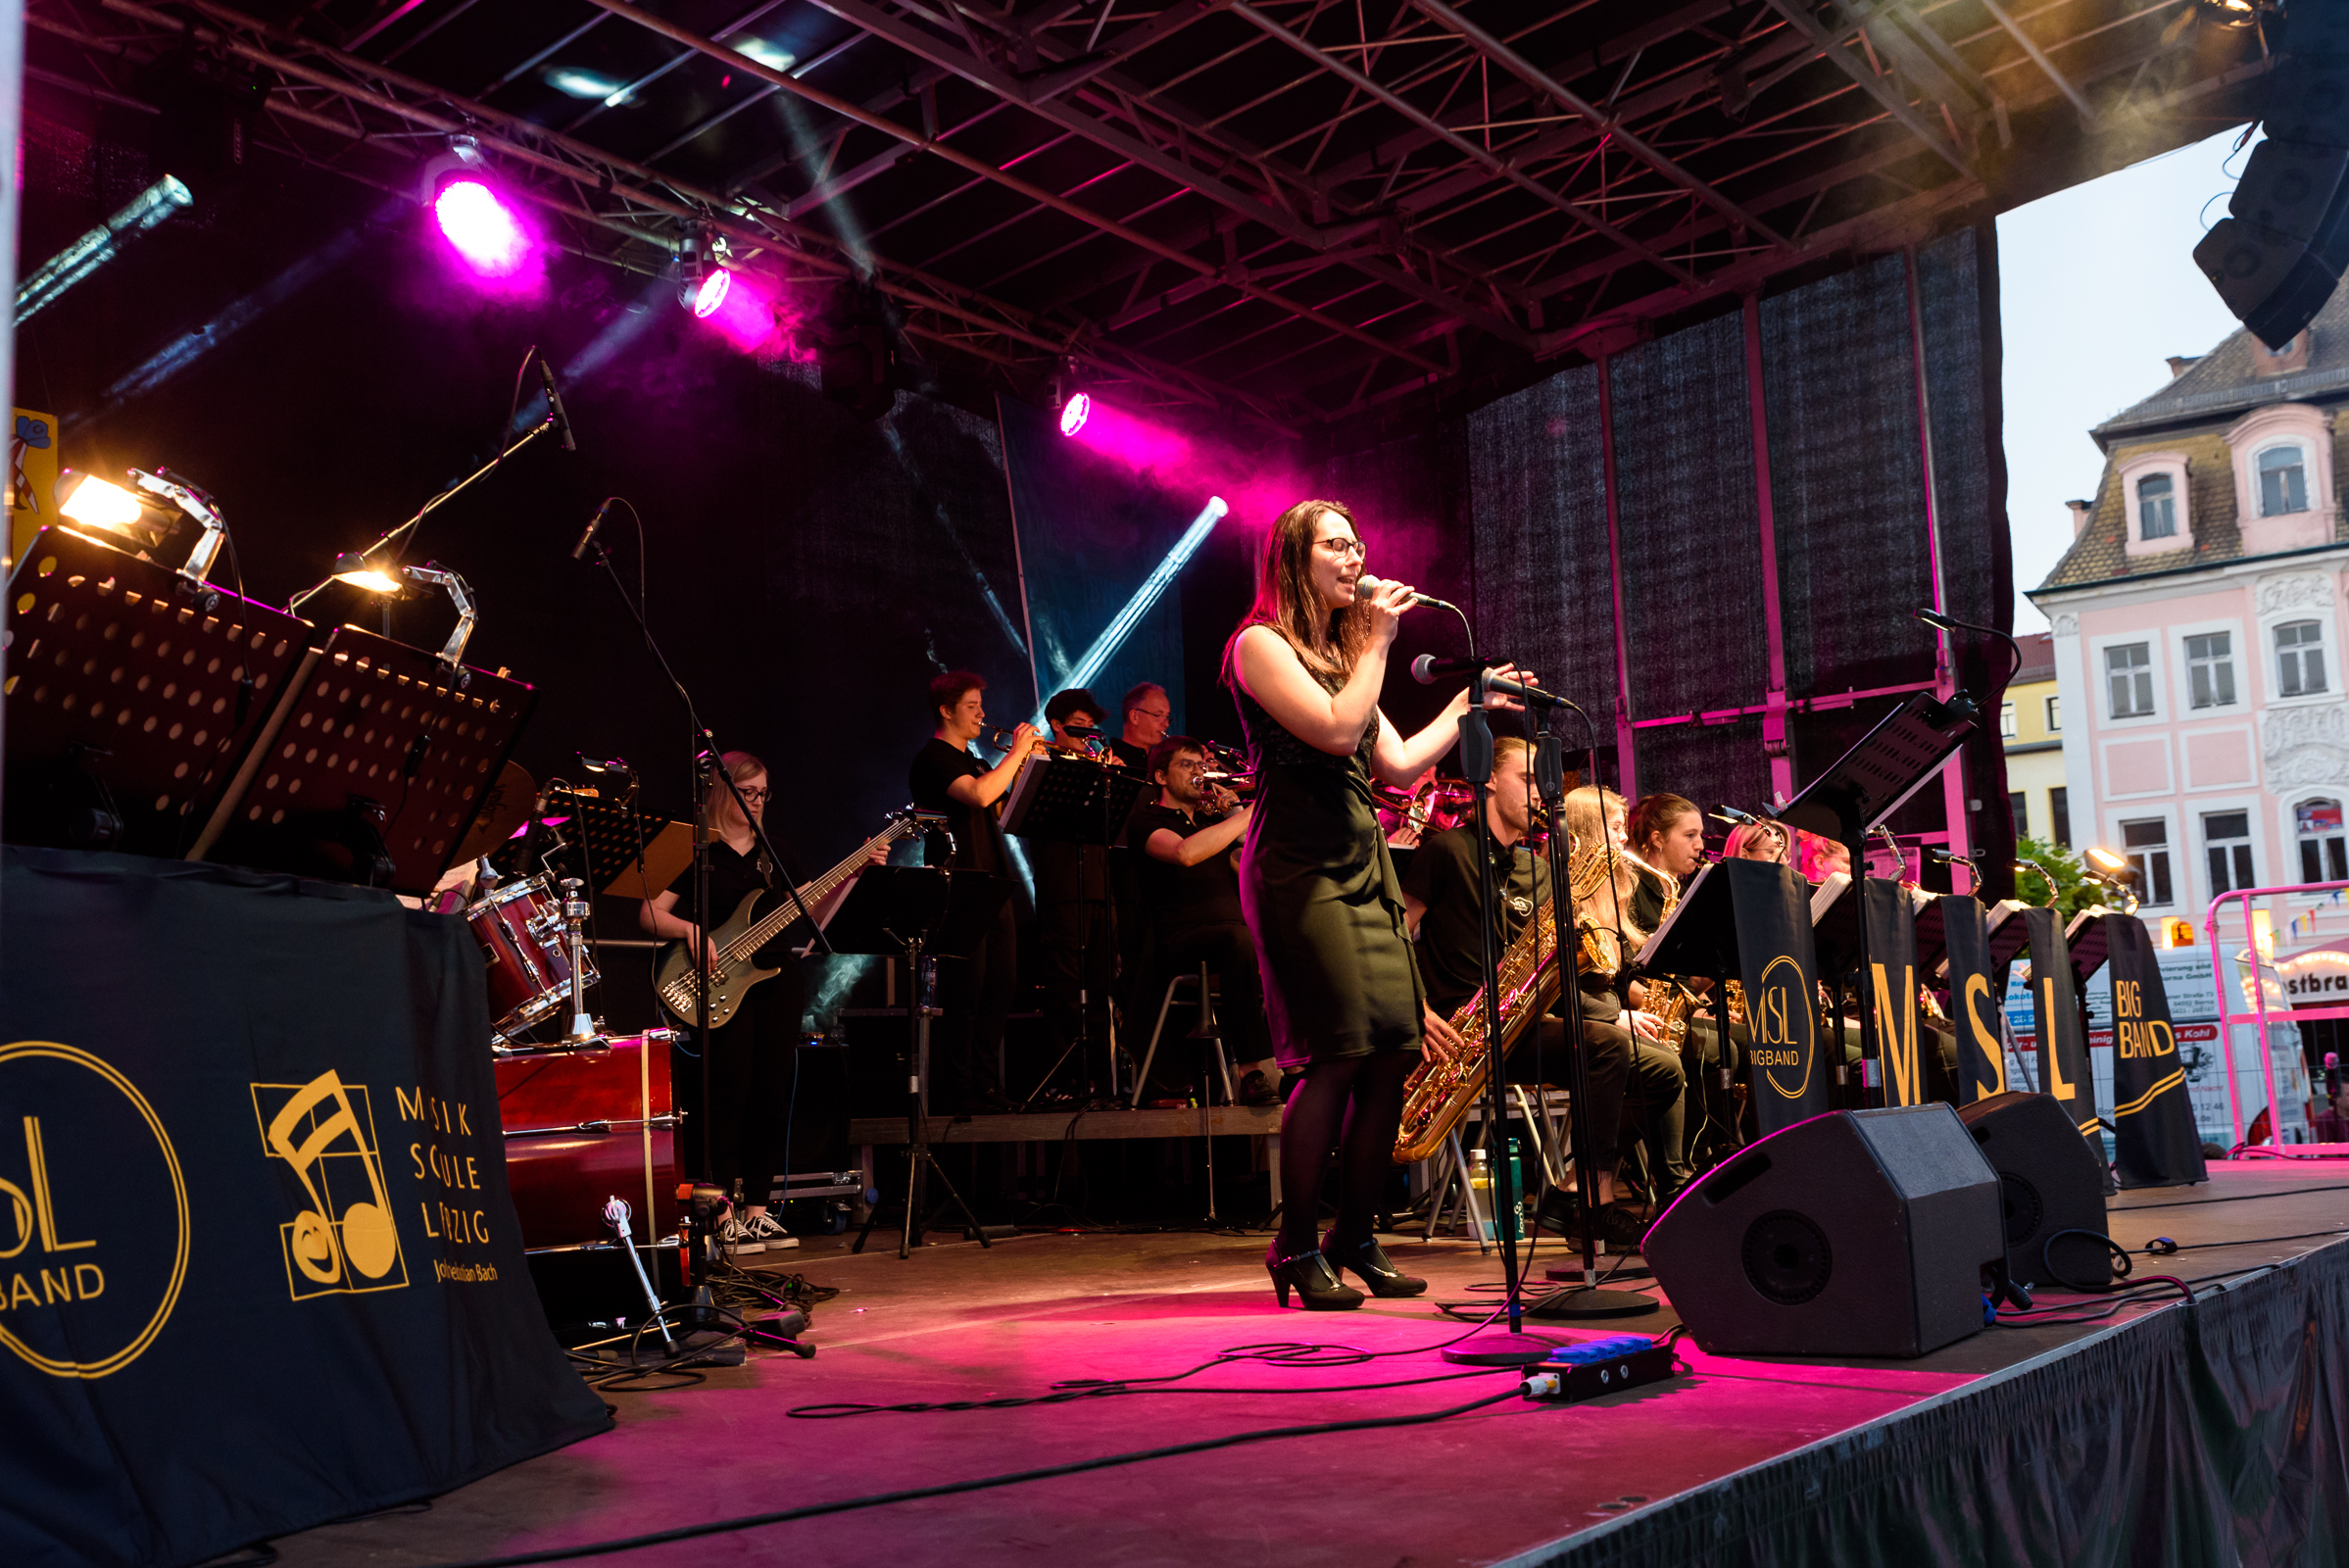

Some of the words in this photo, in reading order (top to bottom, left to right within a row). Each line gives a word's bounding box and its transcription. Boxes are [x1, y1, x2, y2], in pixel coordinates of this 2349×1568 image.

[2116, 980, 2142, 1018] BIG
[2283, 971, 2348, 996] stbra
[1871, 962, 1921, 1107] M
[1965, 973, 2005, 1101] S
[2043, 977, 2076, 1101] L
[2119, 1020, 2176, 1059] BAND
[395, 1086, 471, 1136] MSIK
[475, 1262, 499, 1282] Bach
